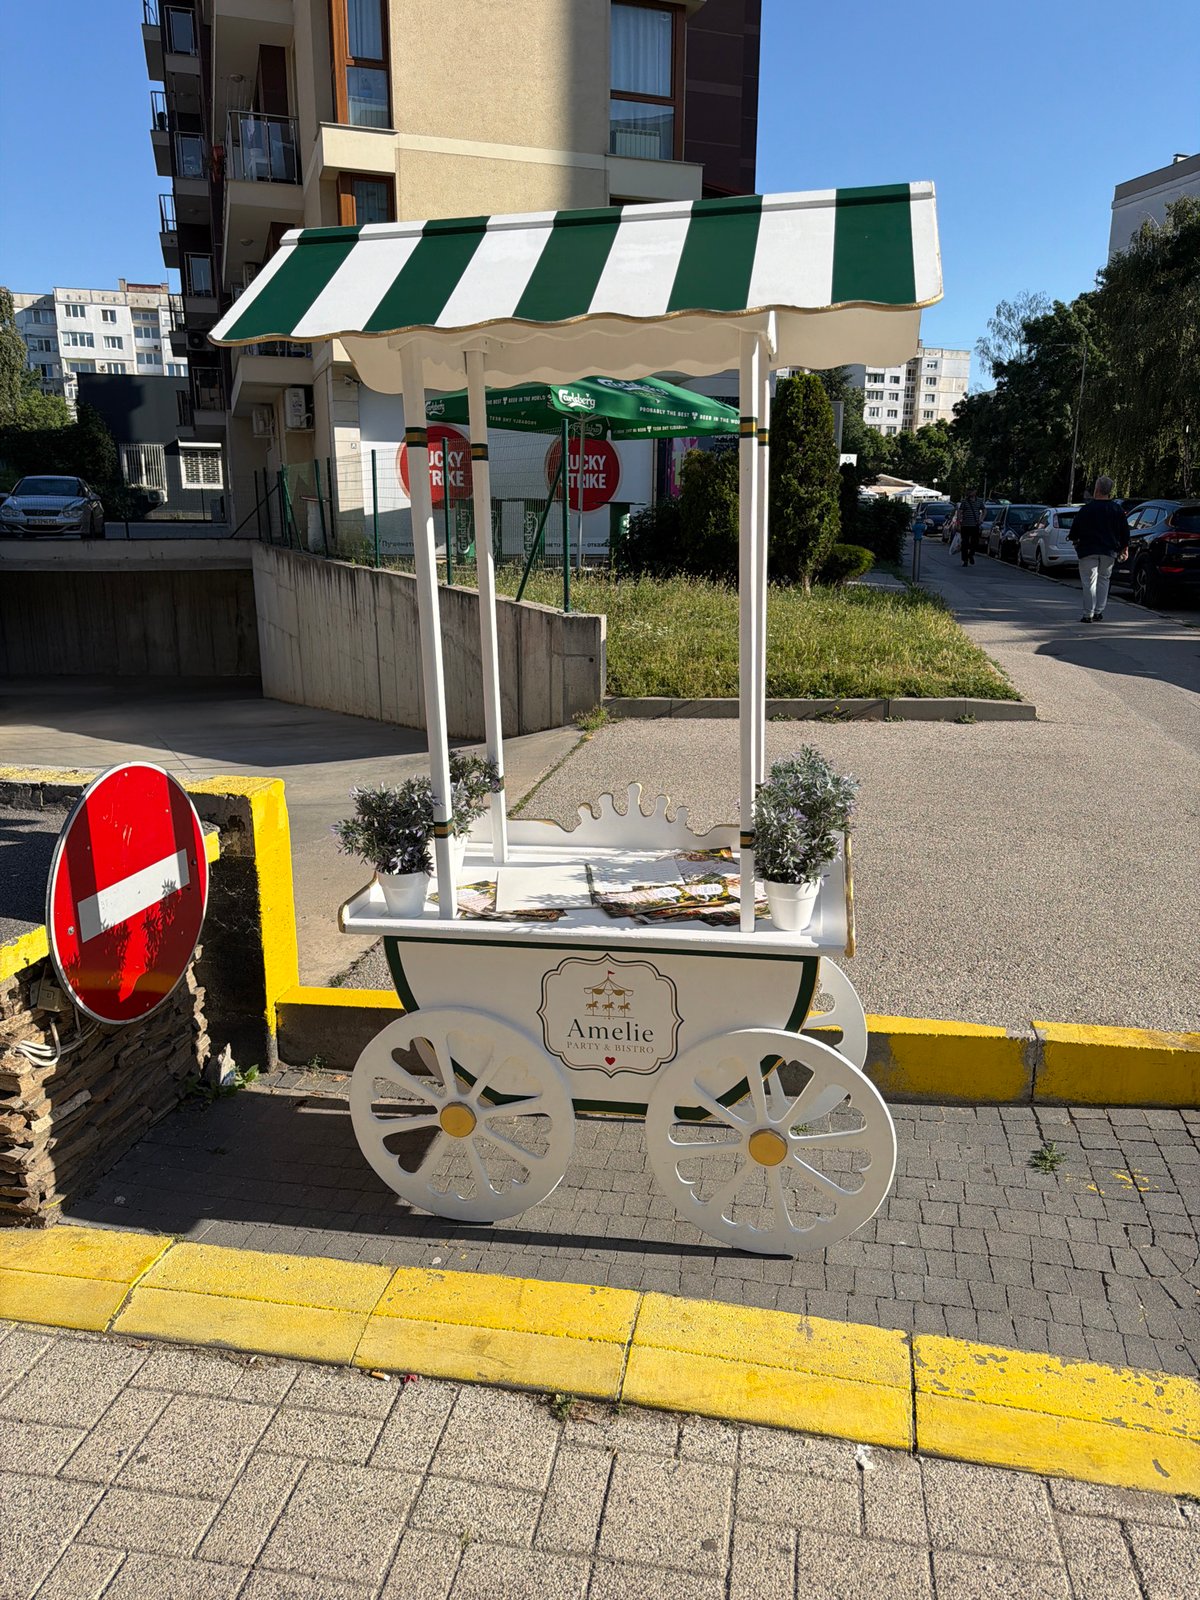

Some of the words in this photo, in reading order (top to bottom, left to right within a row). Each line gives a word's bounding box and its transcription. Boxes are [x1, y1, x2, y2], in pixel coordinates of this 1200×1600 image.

[558, 389, 596, 410] Carlsberg
[640, 406, 666, 415] PROBABLY
[567, 1018, 654, 1043] Amelie
[567, 1041, 600, 1050] PARTY
[603, 1044, 611, 1052] &
[614, 1044, 654, 1054] BISTRO
